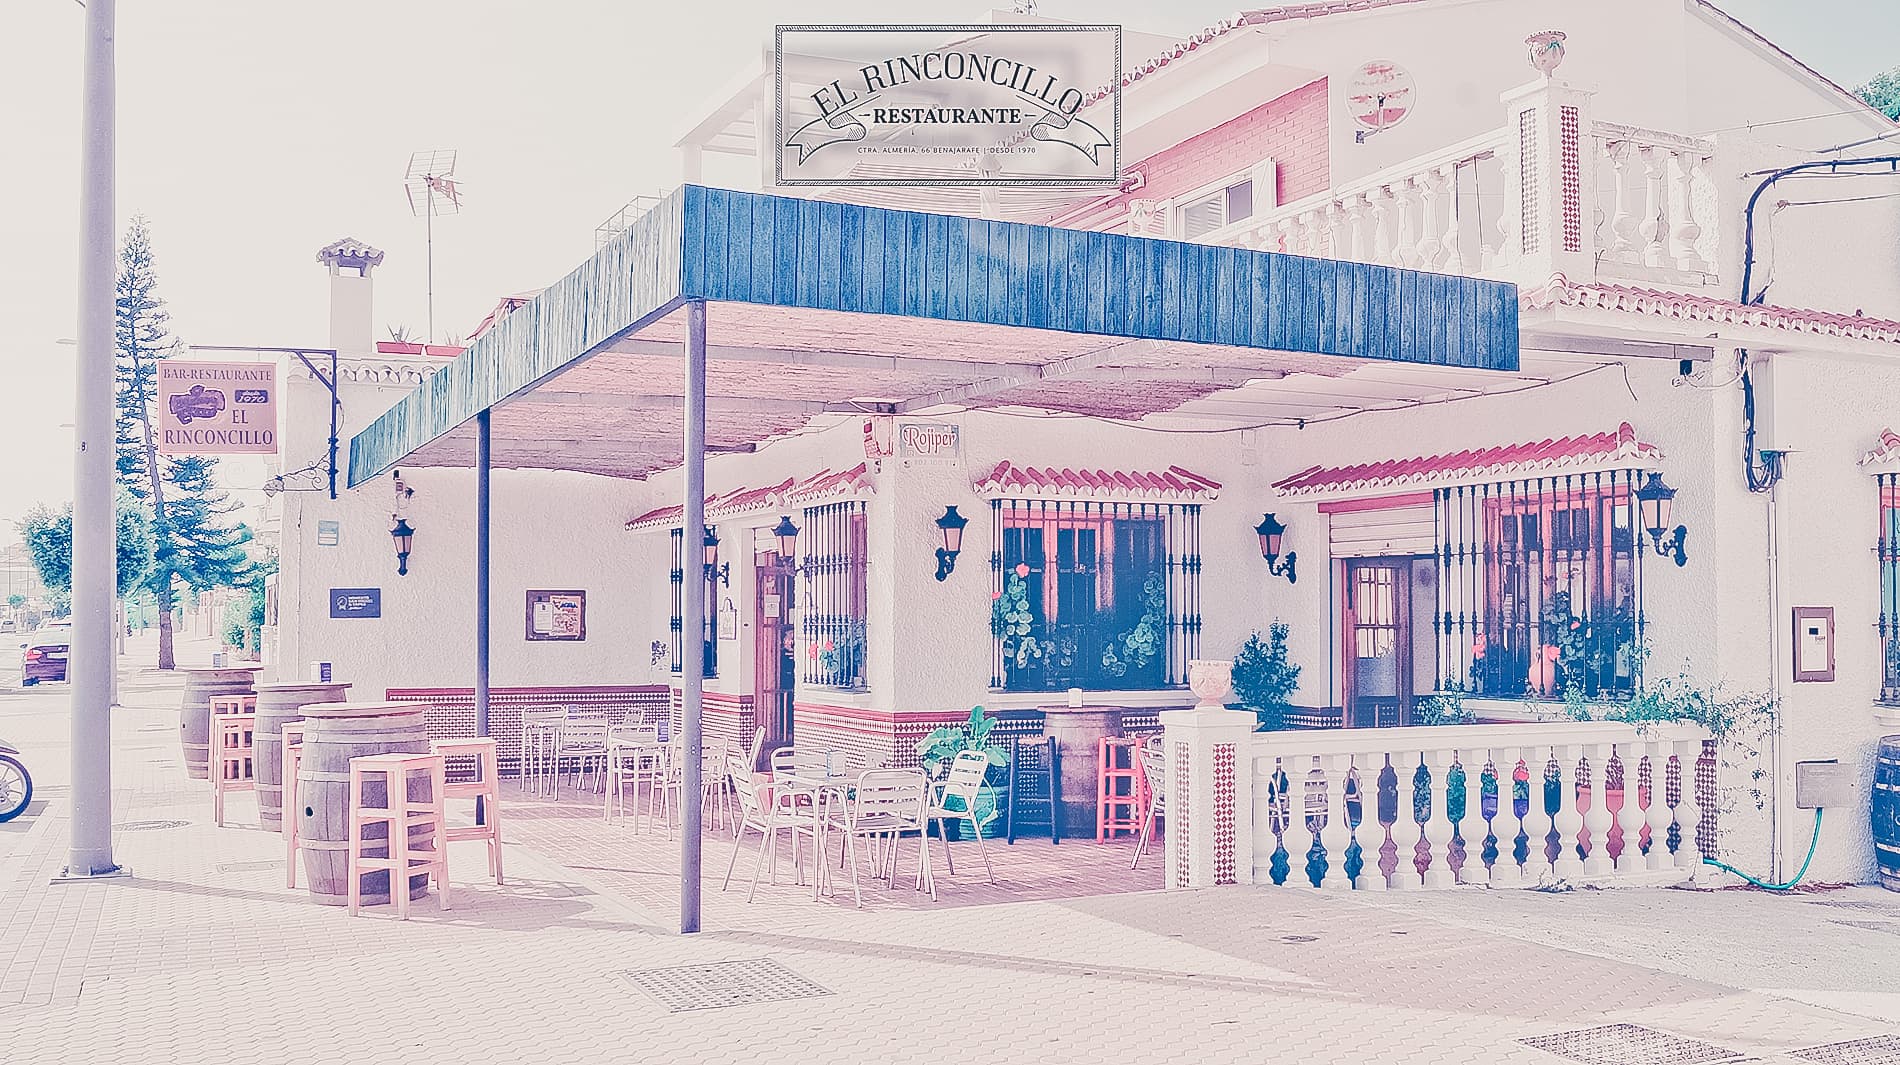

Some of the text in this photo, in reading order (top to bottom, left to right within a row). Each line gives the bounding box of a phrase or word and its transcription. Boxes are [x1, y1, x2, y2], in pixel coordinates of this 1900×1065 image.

[163, 368, 272, 381] BAR-RESTAURANTE
[232, 409, 249, 424] EL
[165, 429, 273, 445] RINCONCILLO
